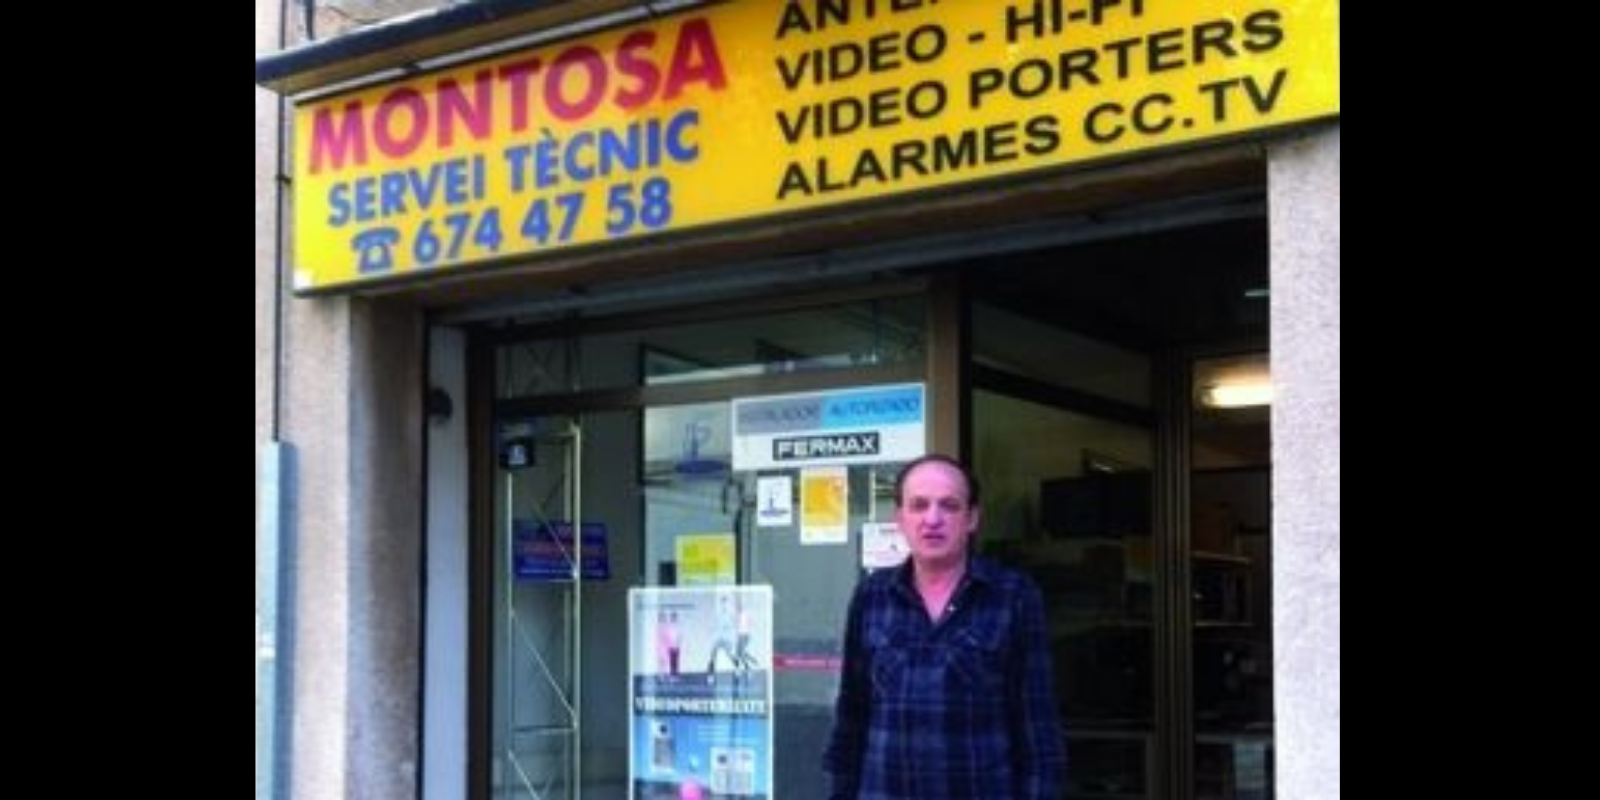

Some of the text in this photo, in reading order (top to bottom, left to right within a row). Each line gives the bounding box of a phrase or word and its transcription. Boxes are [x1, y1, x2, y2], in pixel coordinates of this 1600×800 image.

[308, 16, 728, 175] MONTOSA
[776, 23, 947, 91] VIDEO
[776, 10, 1284, 144] VIDEO PORTERS
[327, 109, 700, 227] SERVEI TÈCNIC
[776, 69, 1289, 199] ALARMES CC.TV
[412, 177, 674, 270] 674 47 58
[778, 435, 875, 459] FERMAX
